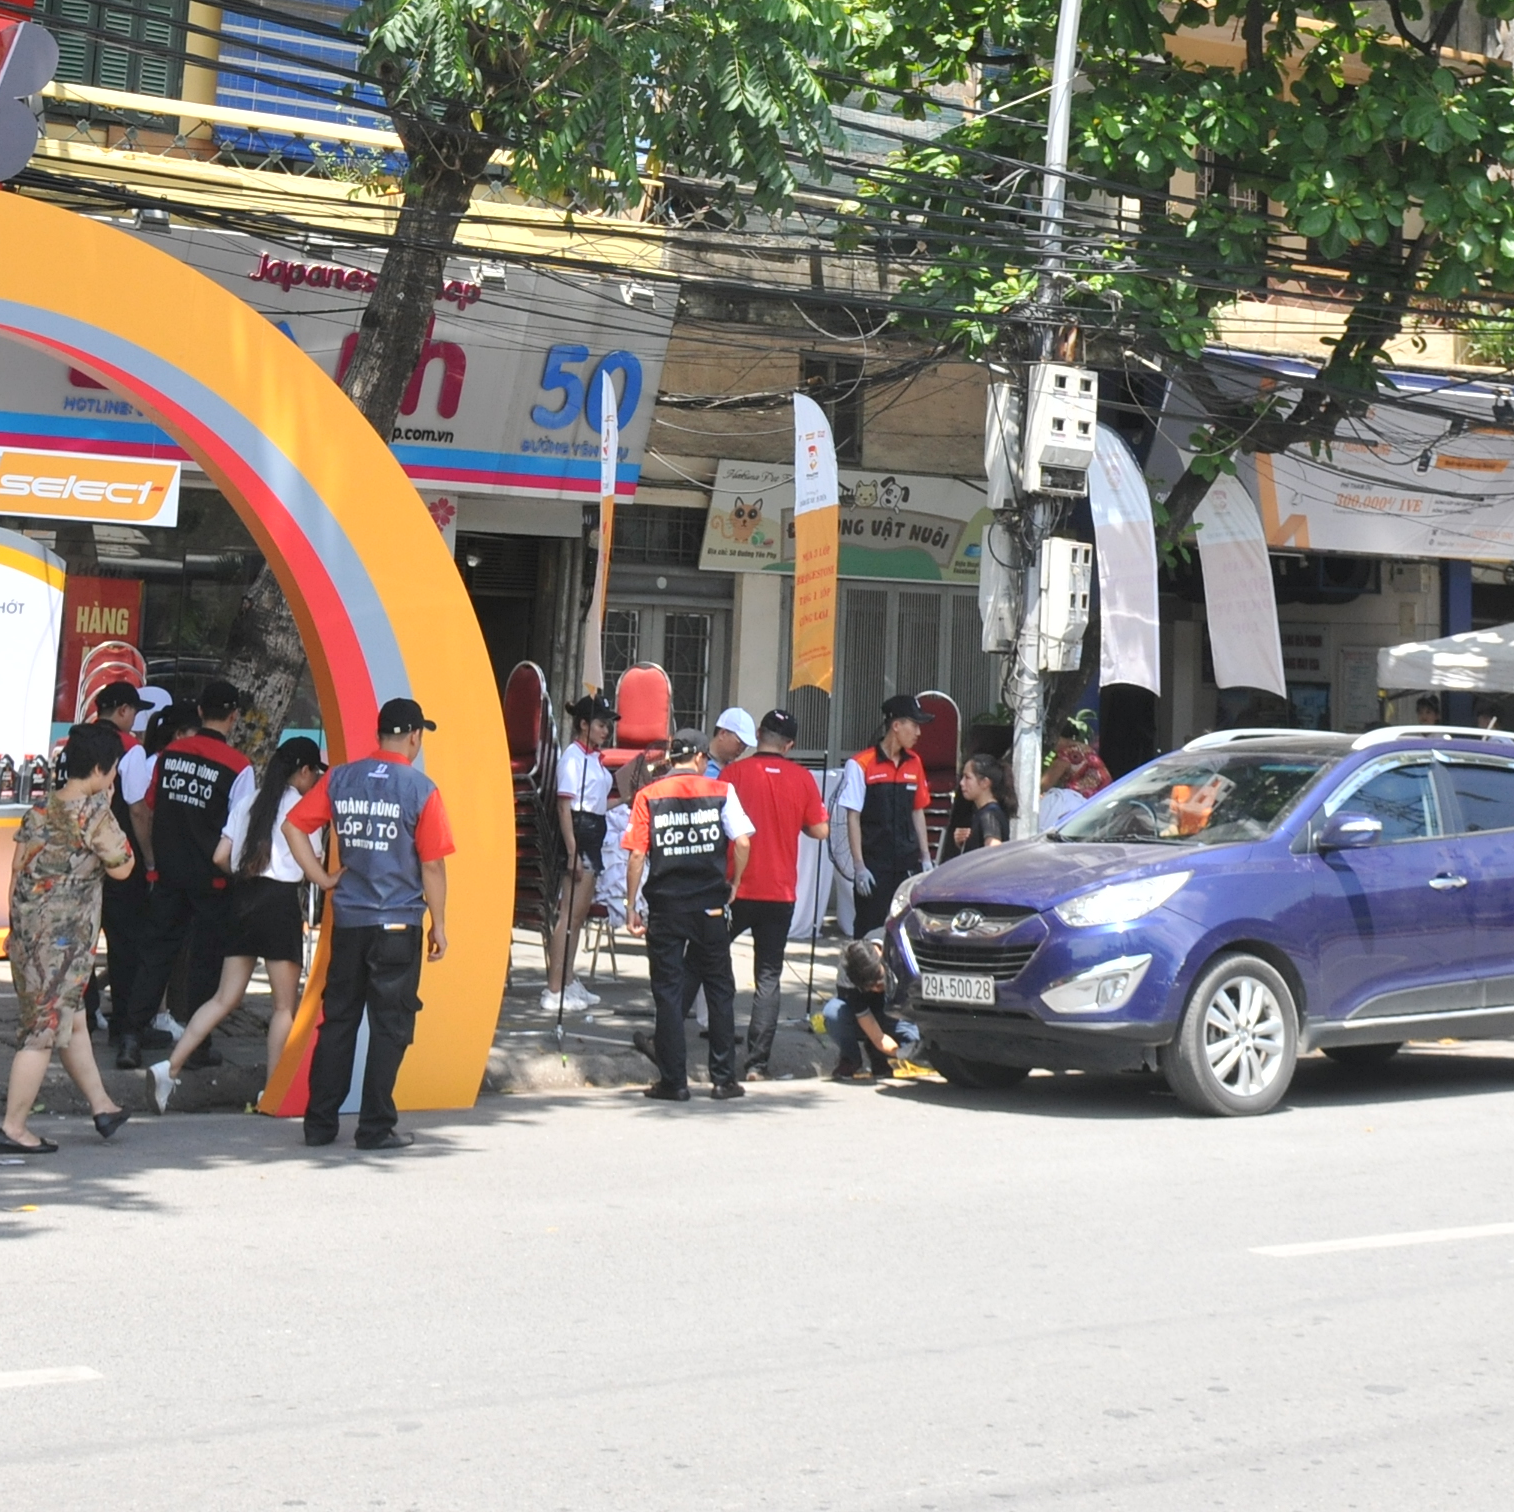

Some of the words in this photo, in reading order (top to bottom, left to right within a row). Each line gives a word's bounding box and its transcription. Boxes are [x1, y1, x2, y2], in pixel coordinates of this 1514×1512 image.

[249, 251, 375, 293] Japanes
[531, 343, 643, 435] 50
[871, 517, 906, 541] VẬT
[909, 524, 950, 550] NUÔI
[75, 601, 130, 636] HÀNG
[162, 773, 186, 791] LỐP
[336, 815, 363, 836] LỐP
[376, 820, 399, 840] TÔ
[654, 810, 689, 829] HOÀNG
[655, 827, 685, 847] LỐP
[687, 827, 698, 844] Ô
[699, 823, 720, 842] TÔ
[924, 975, 992, 1000] 29A-500.28
